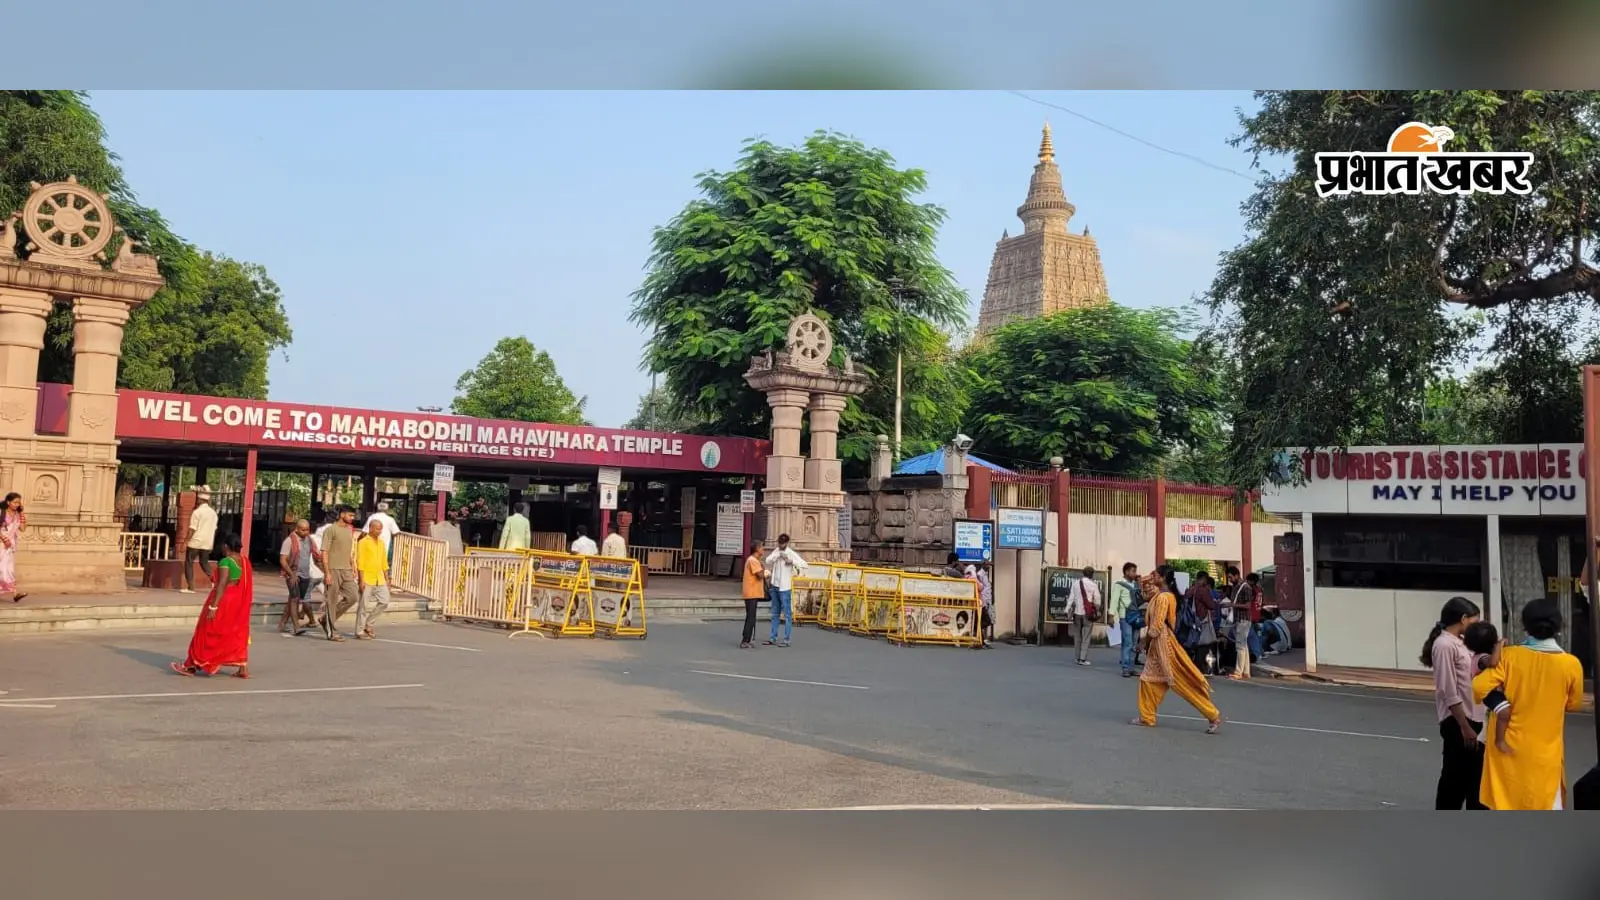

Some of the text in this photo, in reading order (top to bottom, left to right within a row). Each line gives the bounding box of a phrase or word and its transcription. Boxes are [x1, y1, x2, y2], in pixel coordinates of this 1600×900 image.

[262, 429, 275, 440] A
[430, 442, 509, 456] HERITAGE
[290, 410, 323, 431] TO
[330, 413, 473, 442] MAHABODHI
[477, 426, 609, 452] MAHAVIHARA
[611, 434, 683, 456] TEMPLE
[1373, 485, 1577, 501] MAY I HELP YOU
[1181, 535, 1216, 544] NO ENTRY
